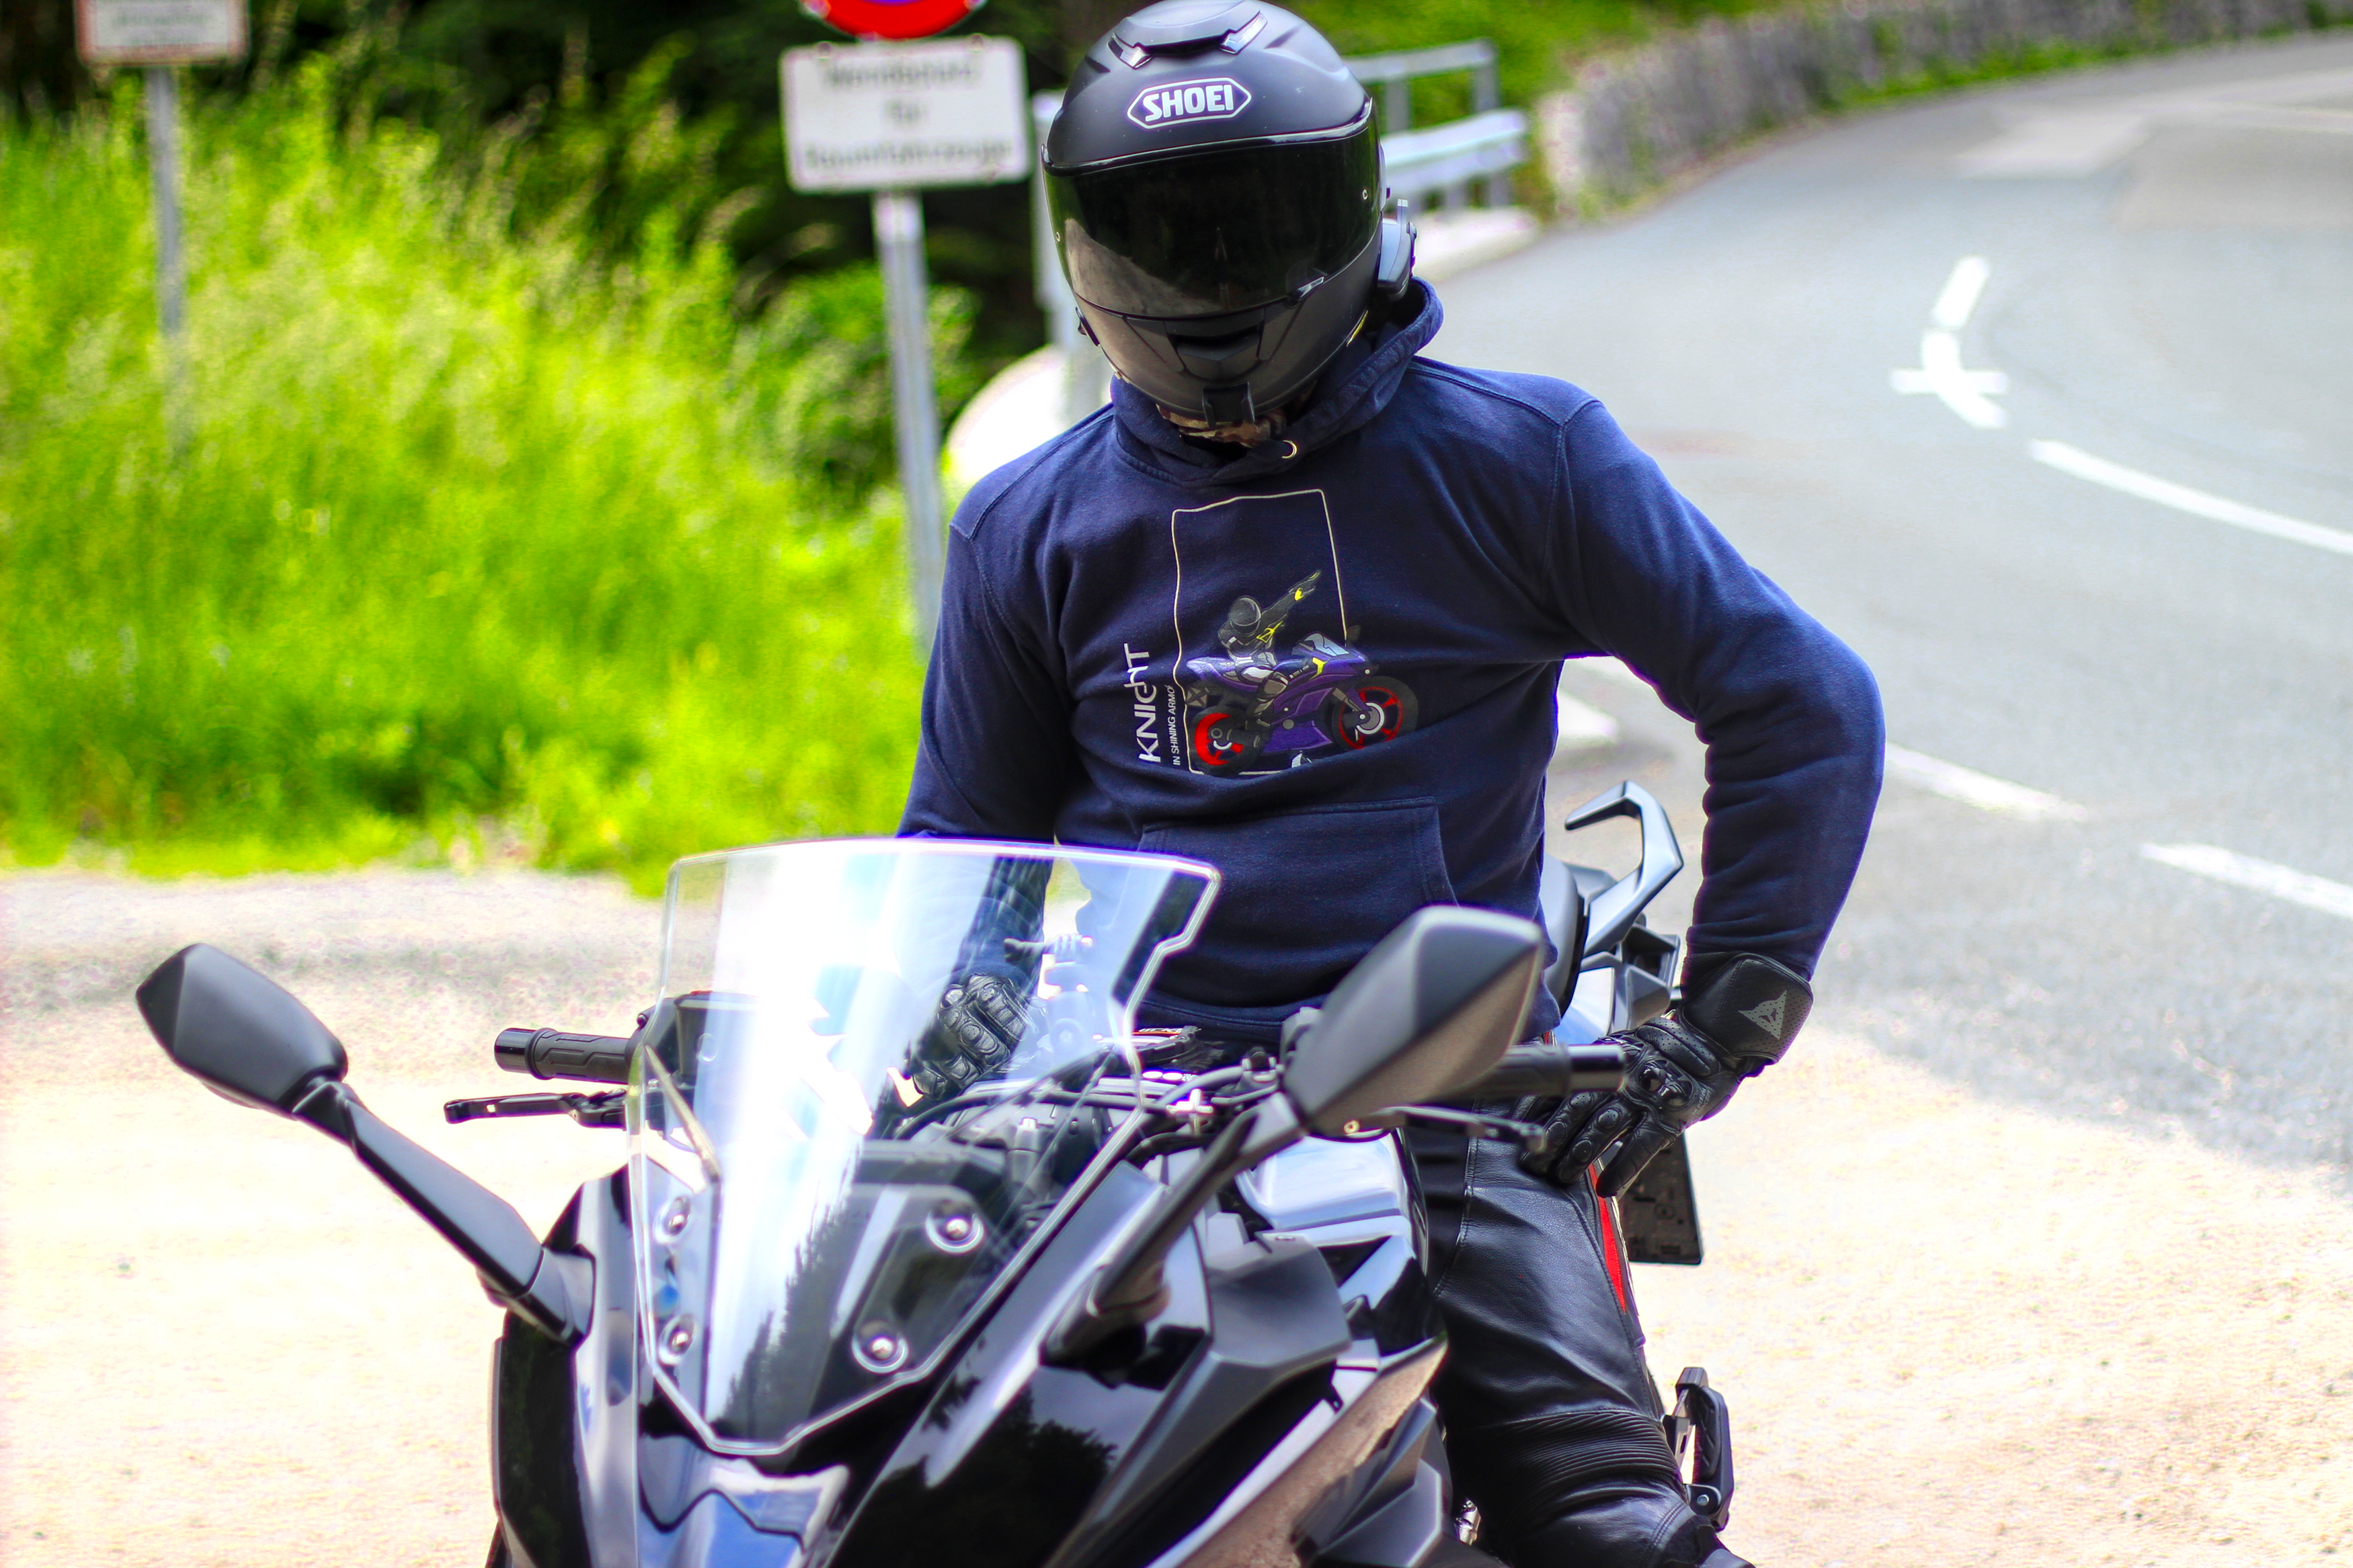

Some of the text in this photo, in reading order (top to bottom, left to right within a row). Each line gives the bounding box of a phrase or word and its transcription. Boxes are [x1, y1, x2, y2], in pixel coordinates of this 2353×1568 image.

[1143, 85, 1234, 122] SHOEI
[1123, 643, 1161, 763] KNIGHT
[1167, 716, 1180, 753] SHINING
